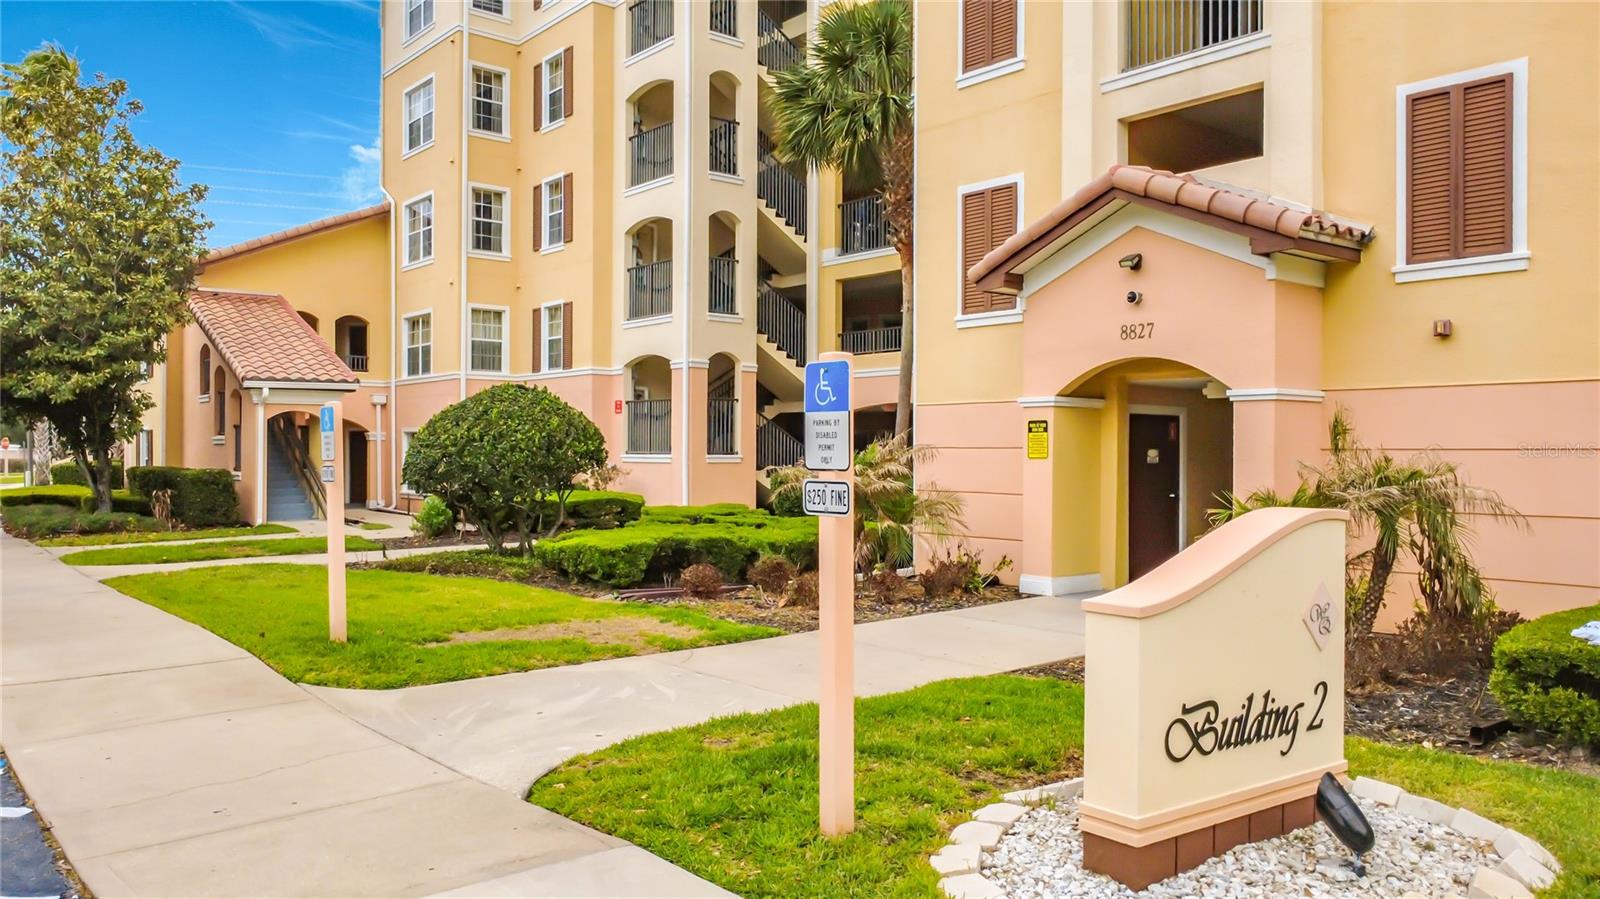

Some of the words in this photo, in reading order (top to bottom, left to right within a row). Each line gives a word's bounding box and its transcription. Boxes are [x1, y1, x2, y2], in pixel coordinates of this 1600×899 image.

[1120, 322, 1155, 341] 8827
[815, 431, 838, 439] DISABLED
[817, 443, 835, 451] PERMIT
[820, 456, 833, 465] ONLY
[807, 489, 827, 506] $250
[830, 489, 847, 507] FINE
[1164, 689, 1305, 763] Building
[1306, 681, 1328, 732] 2
